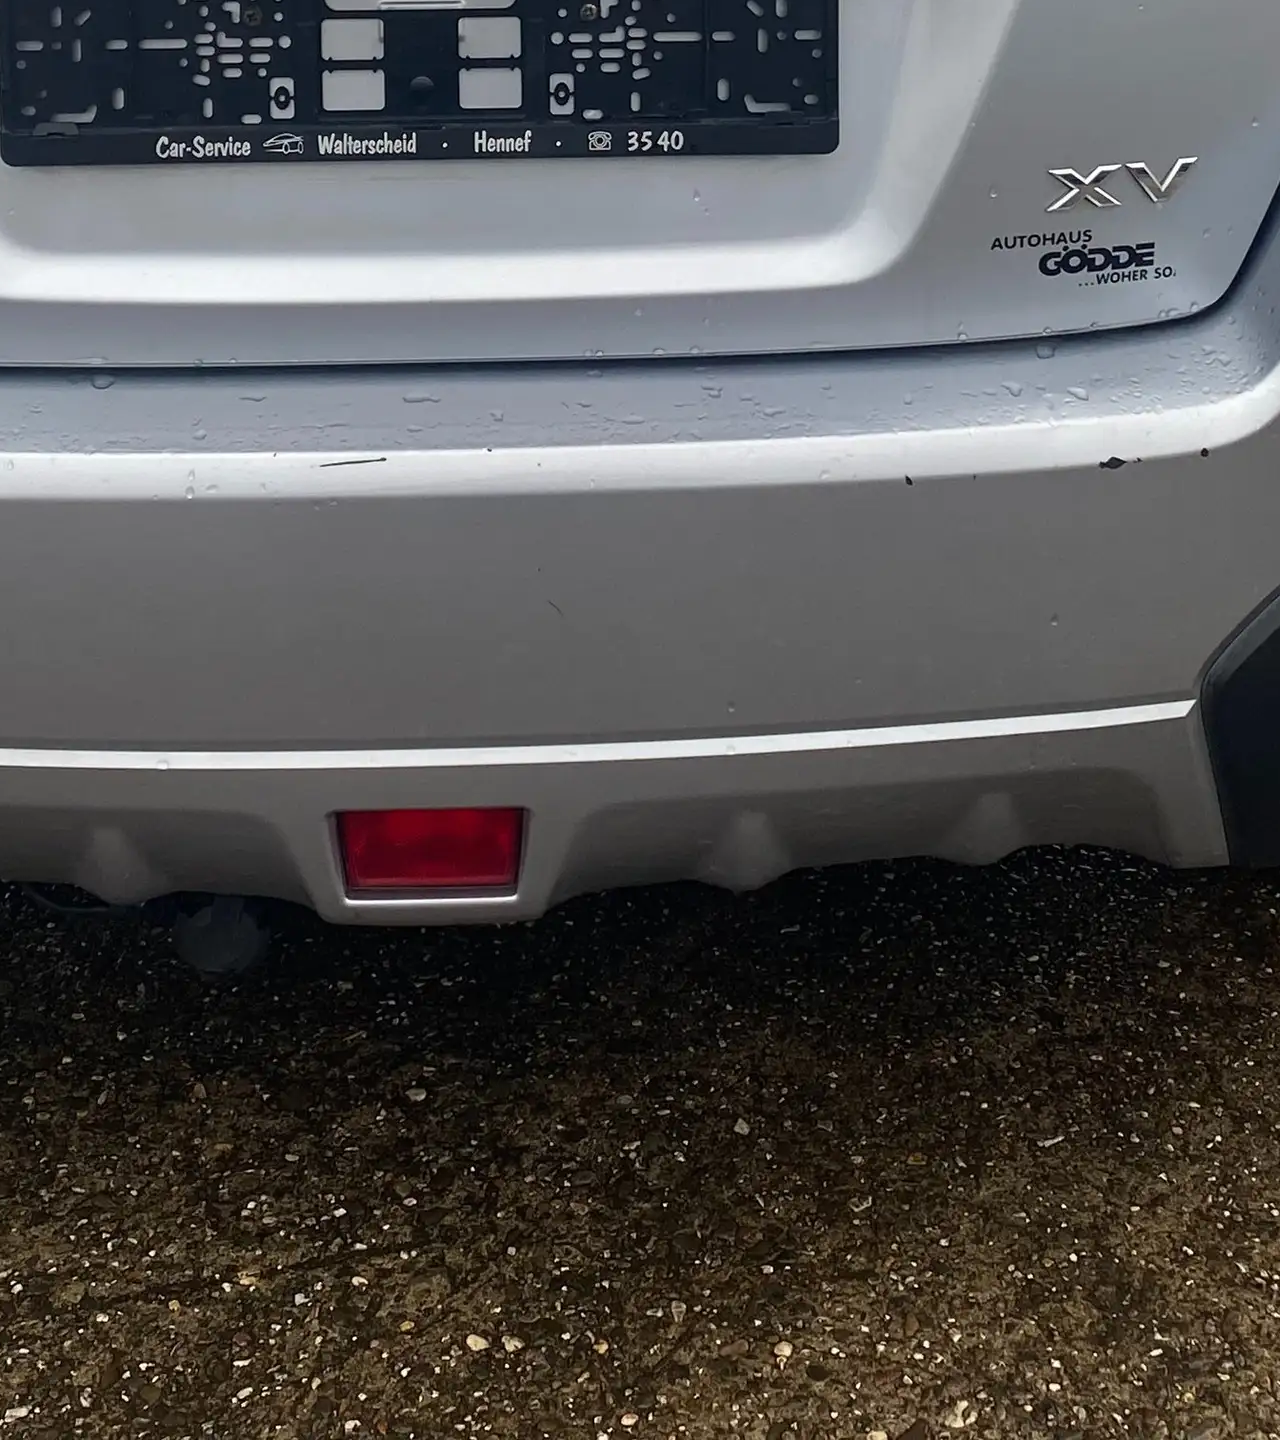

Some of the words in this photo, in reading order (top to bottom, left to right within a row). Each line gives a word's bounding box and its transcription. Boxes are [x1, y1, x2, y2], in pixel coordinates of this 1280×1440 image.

[155, 133, 251, 158] Car-Service
[317, 131, 417, 155] Walterscheid
[474, 129, 532, 153] Hennef
[1045, 156, 1198, 212] XV
[990, 228, 1093, 251] AUTOHAUS
[1038, 241, 1156, 276] GÖDDE
